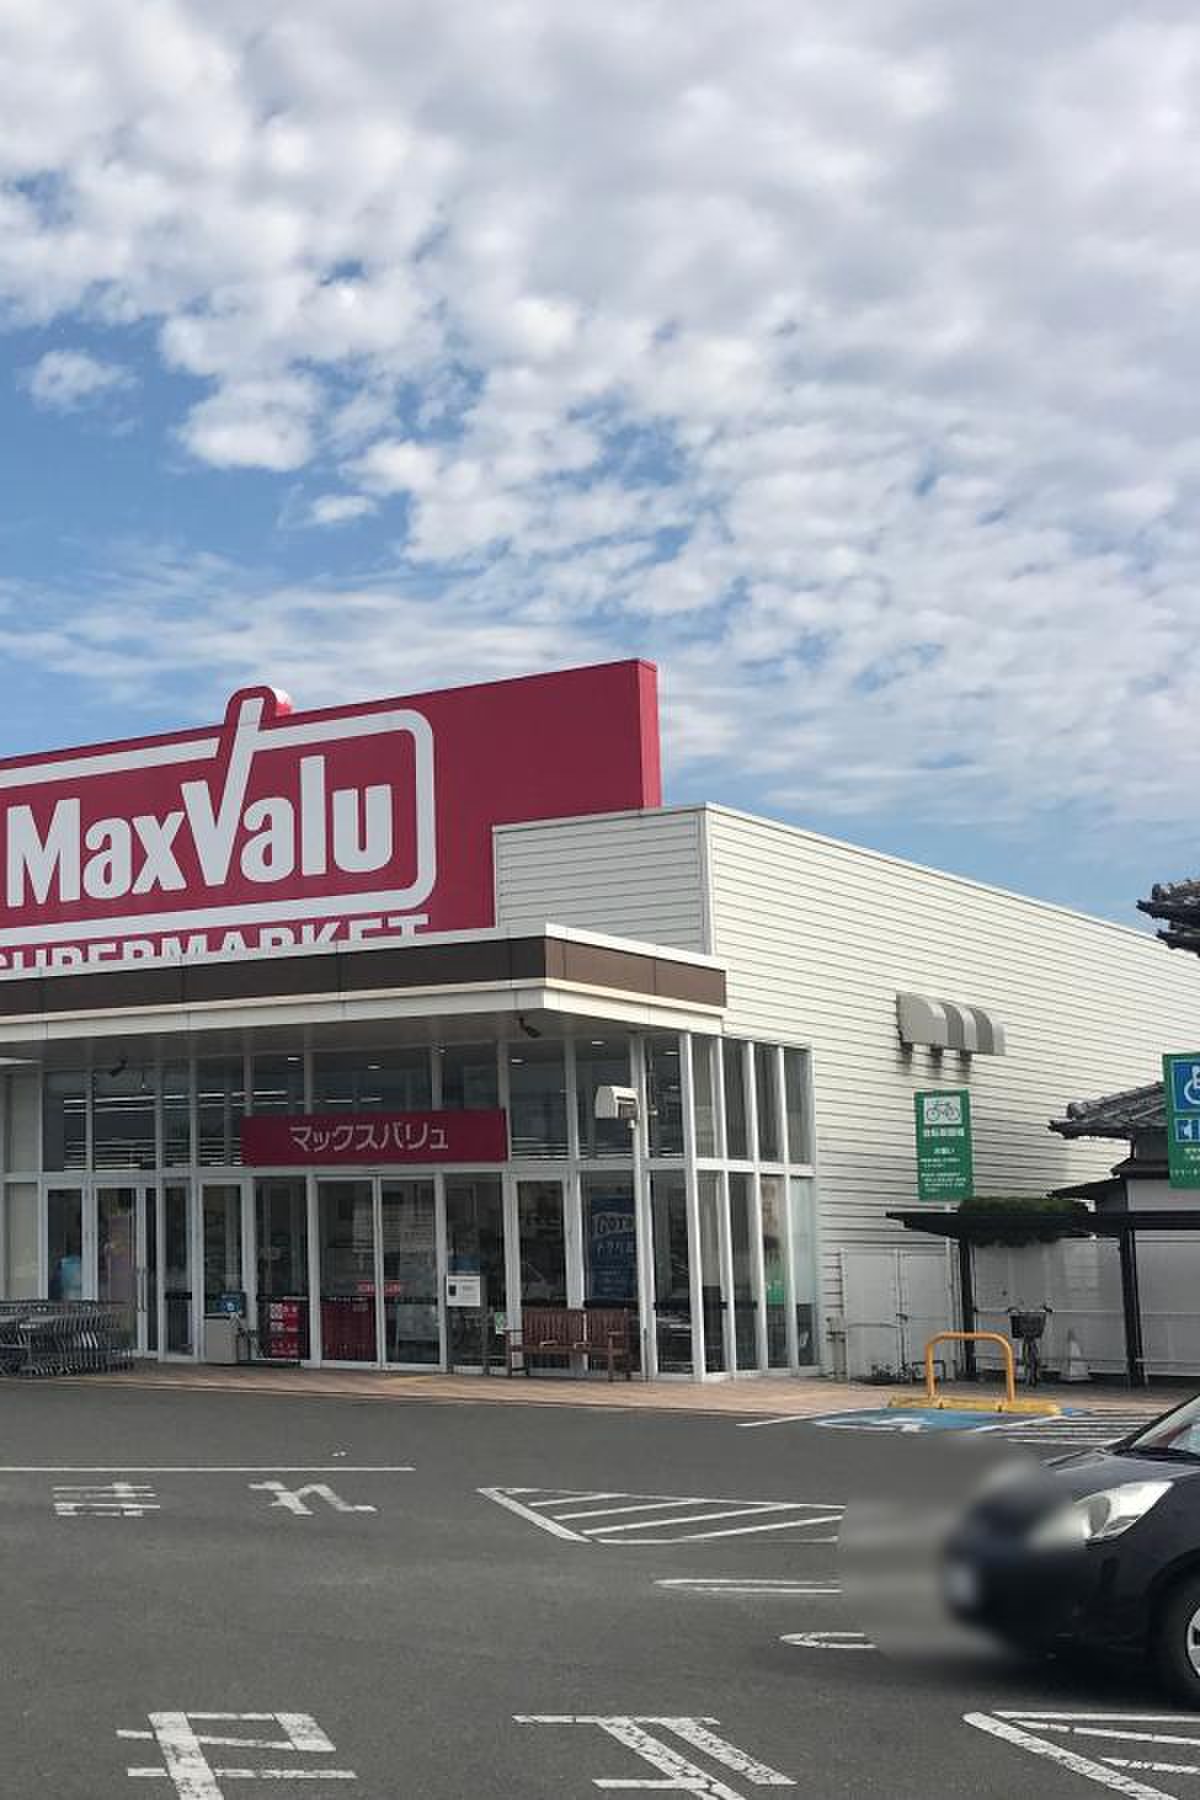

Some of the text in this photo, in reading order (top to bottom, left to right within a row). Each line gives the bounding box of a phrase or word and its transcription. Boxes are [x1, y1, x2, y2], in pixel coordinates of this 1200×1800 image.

[6, 697, 393, 909] MaxValu
[289, 1122, 449, 1152] マックスバリュ
